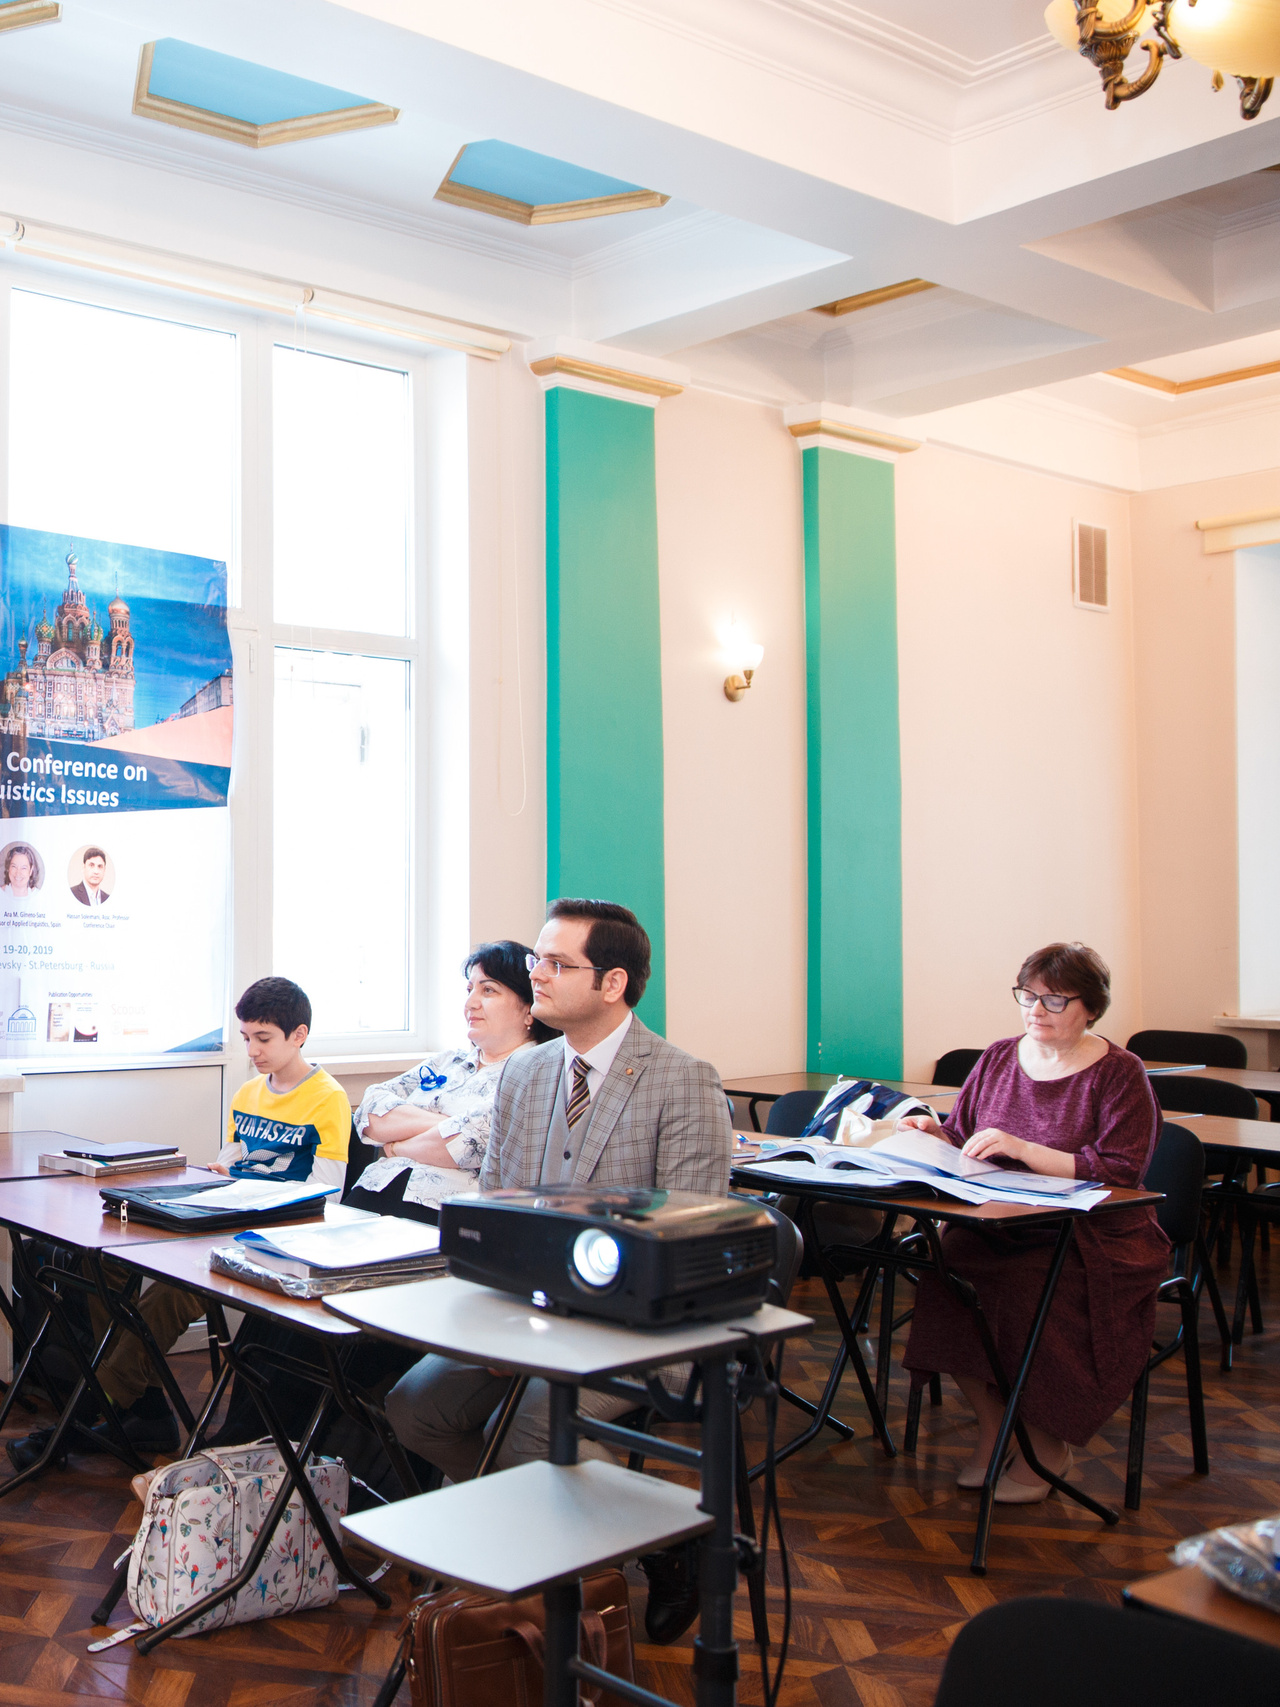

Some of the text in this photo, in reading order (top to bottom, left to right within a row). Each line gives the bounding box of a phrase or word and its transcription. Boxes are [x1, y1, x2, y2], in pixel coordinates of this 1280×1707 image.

[6, 751, 118, 779] Conference
[123, 764, 147, 782] on
[61, 786, 120, 808] Issues
[7, 919, 12, 927] of
[12, 920, 28, 928] Applied
[50, 921, 62, 929] Spain
[3, 945, 31, 956] 19-20,
[33, 946, 53, 955] 2019
[90, 962, 114, 970] Russia
